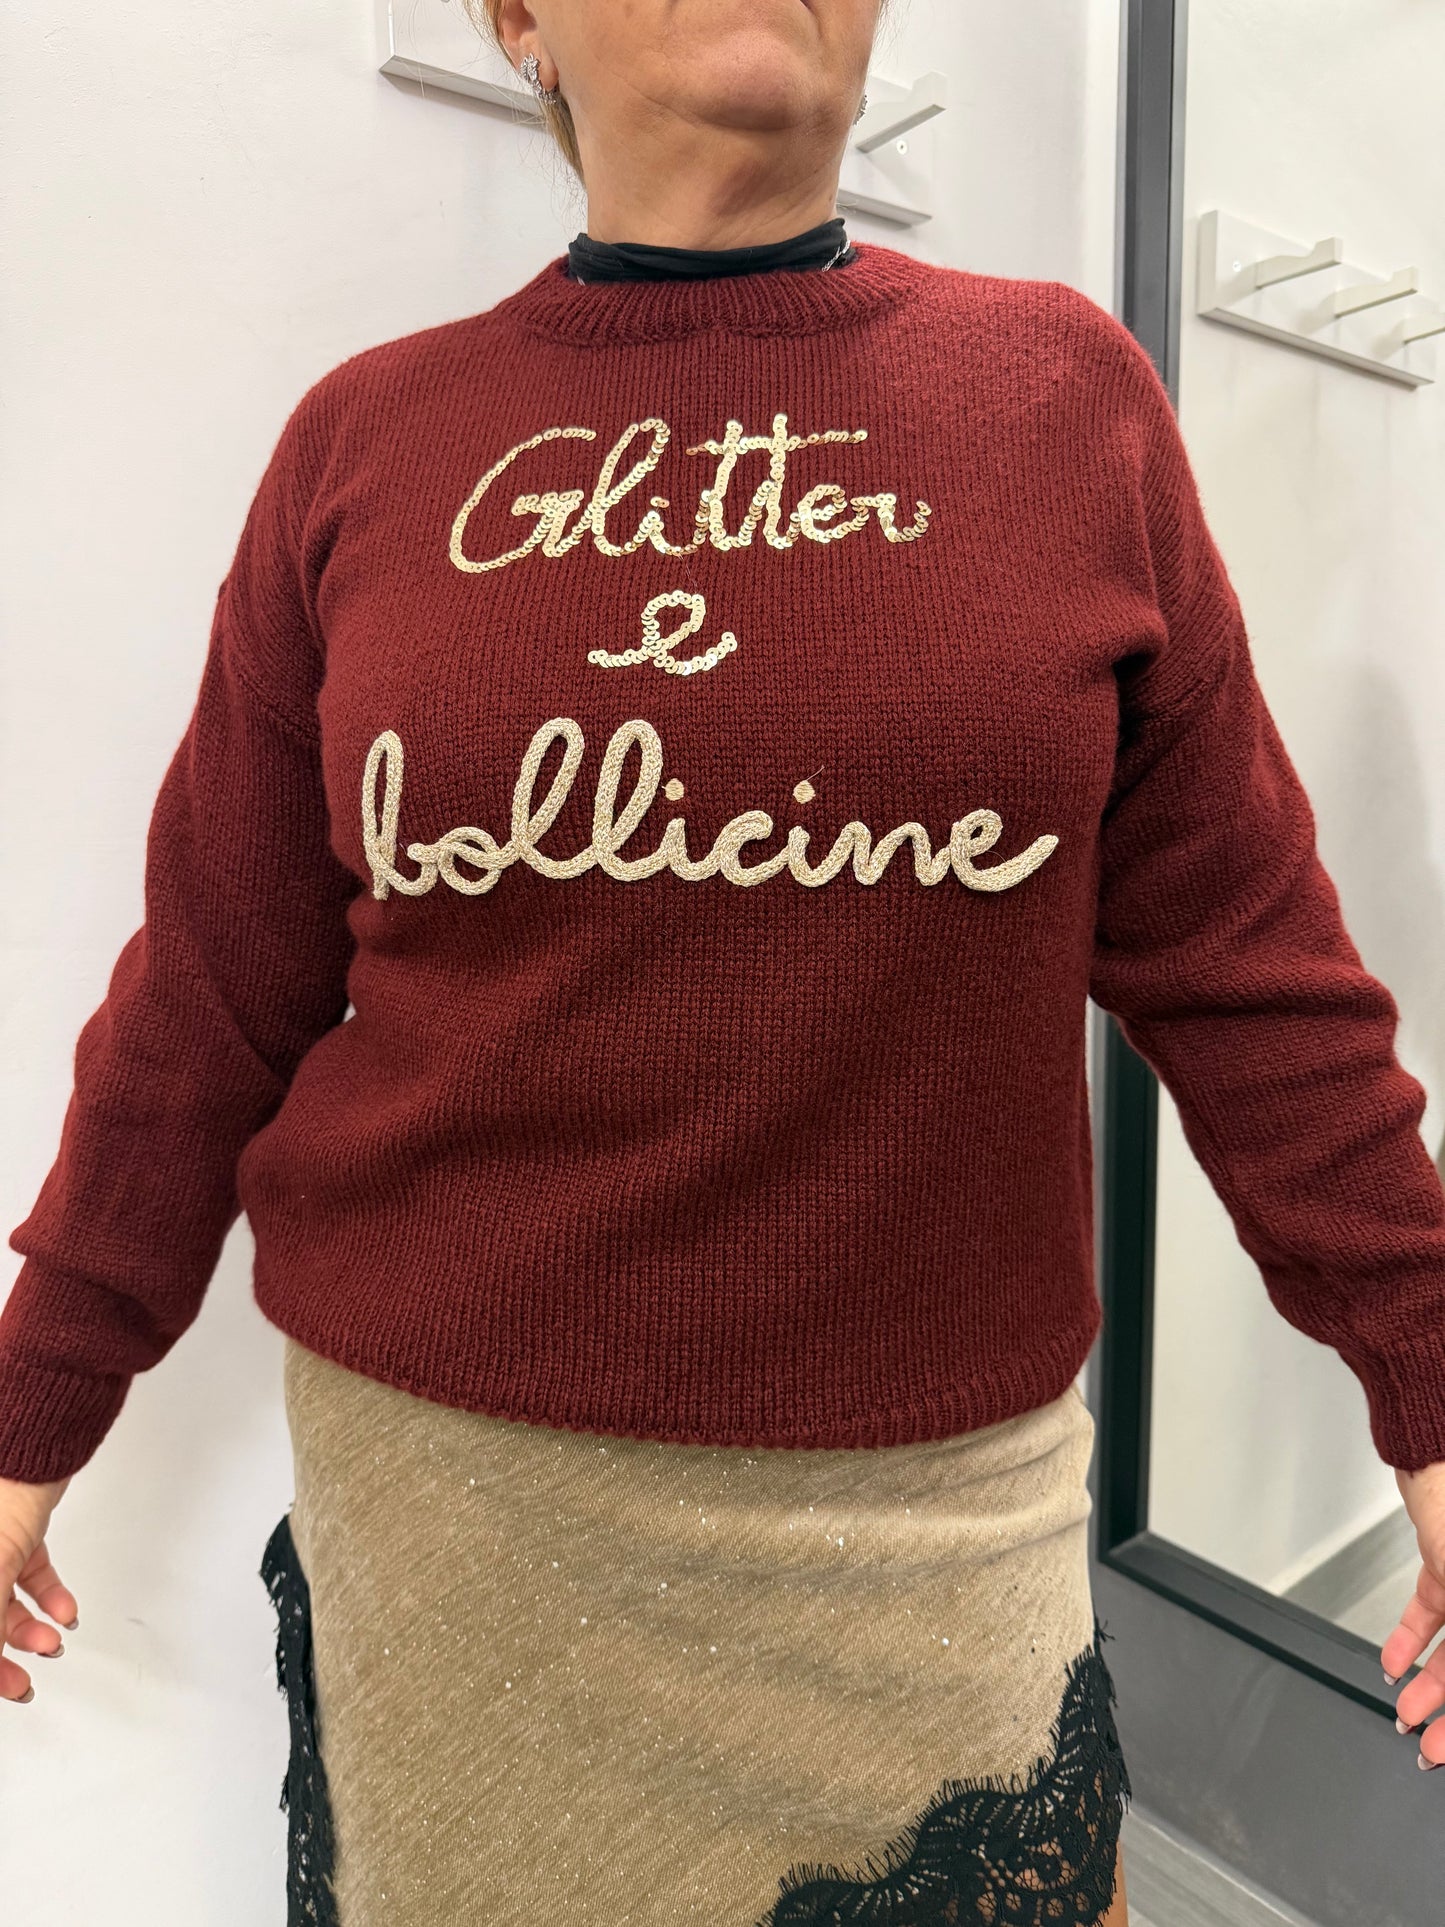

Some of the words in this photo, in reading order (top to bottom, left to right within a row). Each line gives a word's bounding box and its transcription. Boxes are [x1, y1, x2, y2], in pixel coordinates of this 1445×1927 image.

[448, 412, 932, 574] Glitter
[587, 589, 738, 677] e
[361, 716, 1060, 901] bollicine
